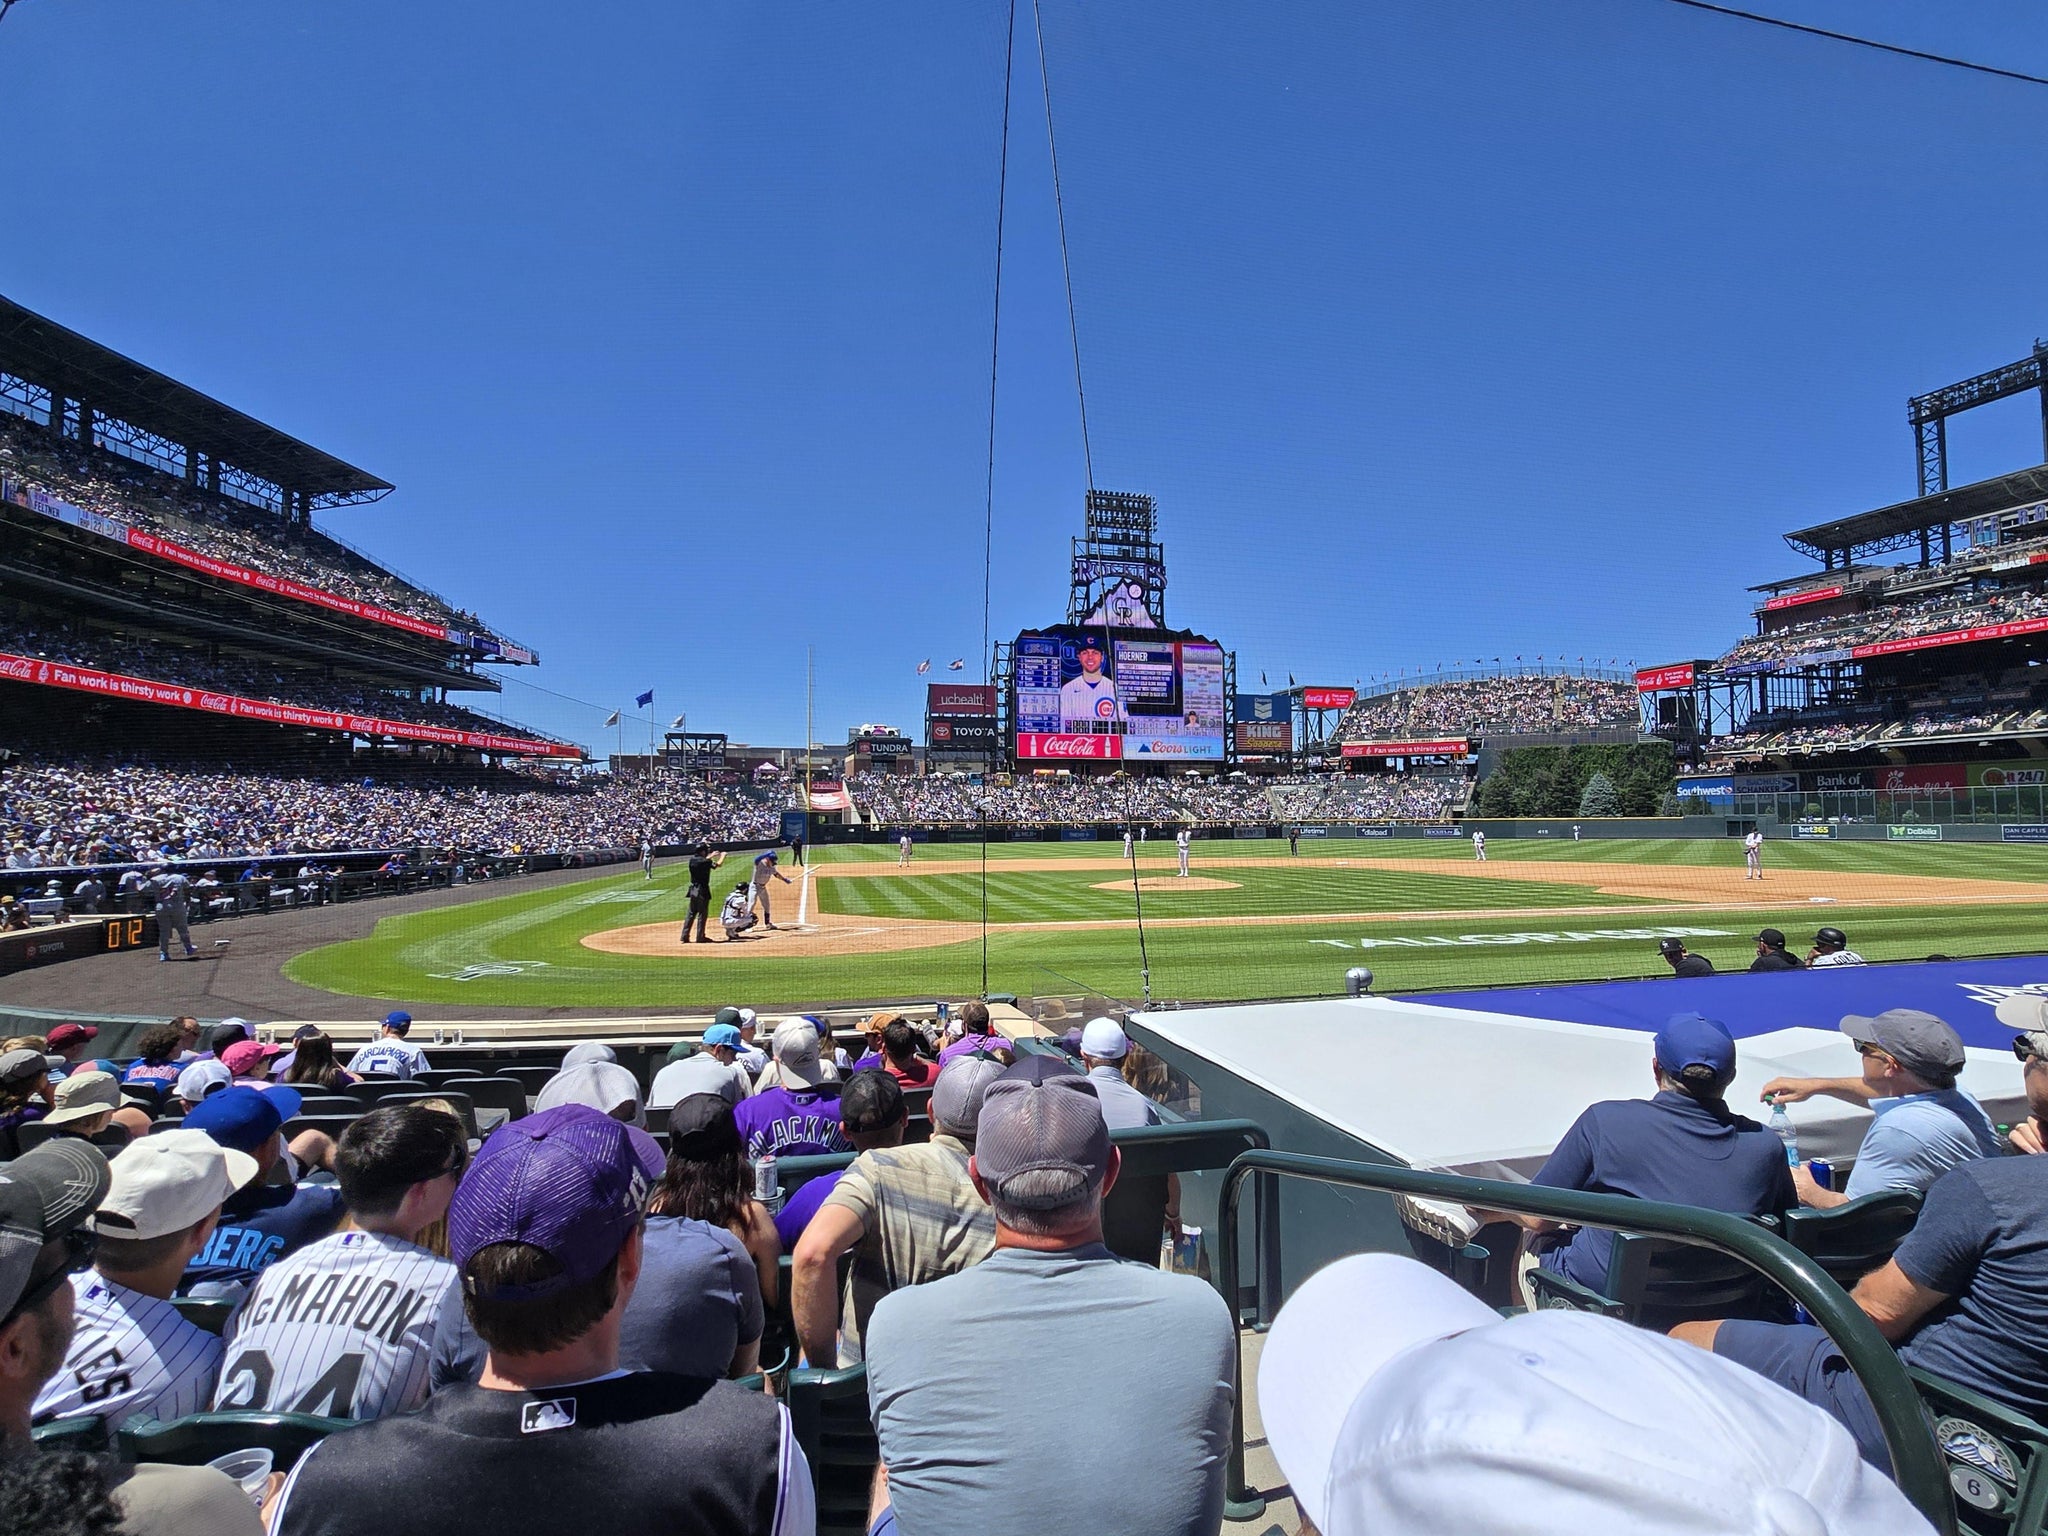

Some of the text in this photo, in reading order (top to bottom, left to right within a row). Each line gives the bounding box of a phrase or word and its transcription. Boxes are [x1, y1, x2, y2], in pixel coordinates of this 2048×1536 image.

[34, 502, 59, 517] FELTNER
[165, 545, 241, 578] Fan work is thirsty work
[1992, 557, 2030, 572] SMASH
[286, 585, 298, 594] Fan
[320, 595, 338, 607] thirsty
[339, 601, 353, 610] work
[387, 615, 398, 623] Fan
[413, 623, 428, 633] thirsty
[428, 627, 439, 635] work
[2025, 622, 2045, 630] work
[1919, 637, 1942, 647] thirsty
[1943, 634, 1960, 643] work
[1118, 652, 1148, 661] HOERNER
[0, 660, 31, 678] ca-Cola
[54, 669, 181, 701] Fan work is thirsty work
[941, 692, 985, 705] uchealth
[240, 703, 333, 725] Fan work is thirsty work
[384, 724, 456, 741] Fan work is thirsty work
[1246, 725, 1281, 738] KING
[871, 743, 908, 752] TUNDRA
[1043, 736, 1096, 756] Coca-Cola
[1152, 740, 1211, 754] Coors LIGHT
[1414, 745, 1437, 753] thirsty
[1438, 744, 1457, 752] work
[1817, 773, 1861, 786] Bank of
[2018, 771, 2045, 782] 24/7
[1677, 784, 1726, 797] Southwest
[1817, 785, 1873, 798] Colorado
[108, 919, 143, 948] 0 12
[1308, 929, 1687, 949] TALLGRASS
[39, 942, 65, 953] TOYOTA
[128, 1065, 180, 1081] SWANSON
[748, 1115, 848, 1161] BLACKMO
[190, 1227, 285, 1271] BERG
[214, 1350, 366, 1418] 24
[1967, 1478, 1981, 1496] 6
